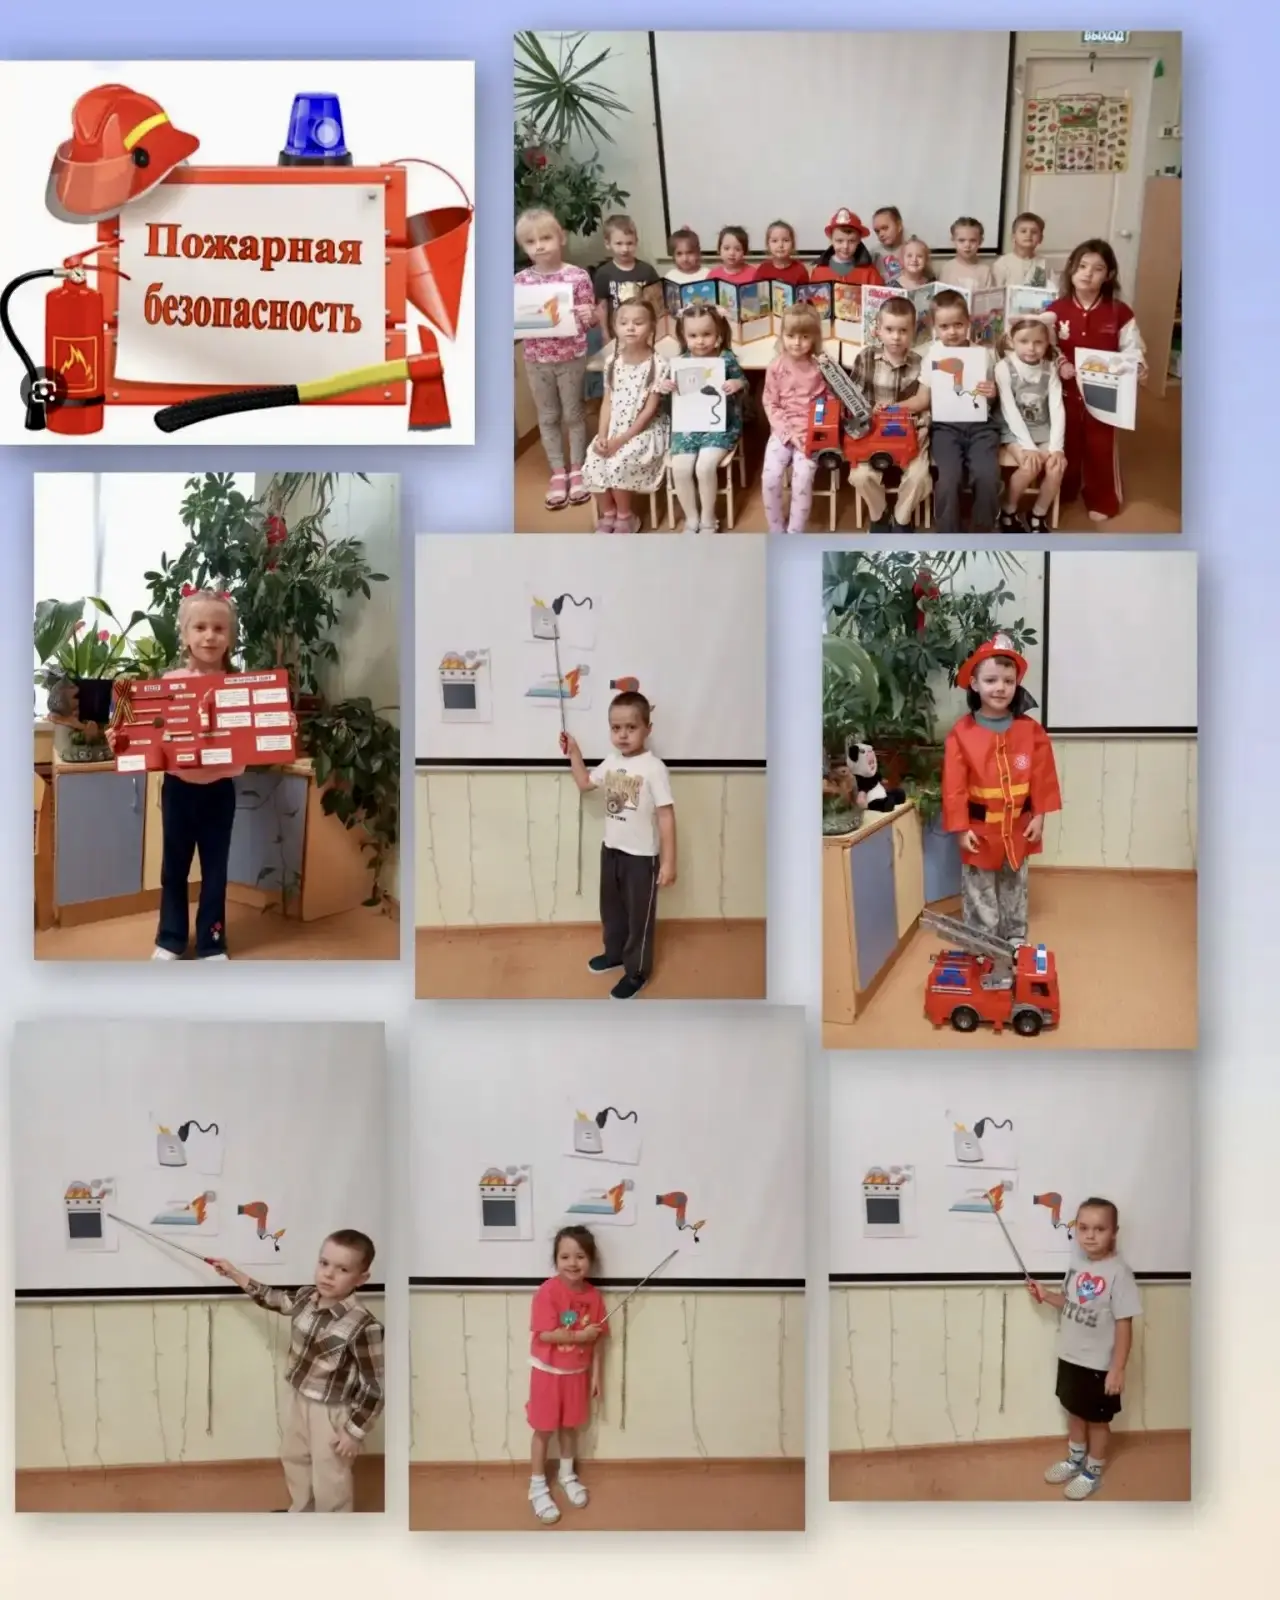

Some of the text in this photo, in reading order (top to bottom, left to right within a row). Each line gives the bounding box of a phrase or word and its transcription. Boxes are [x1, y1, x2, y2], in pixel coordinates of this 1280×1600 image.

[1084, 30, 1125, 42] ВЫХОД
[144, 222, 363, 272] Пожарная
[143, 282, 363, 334] безопасность
